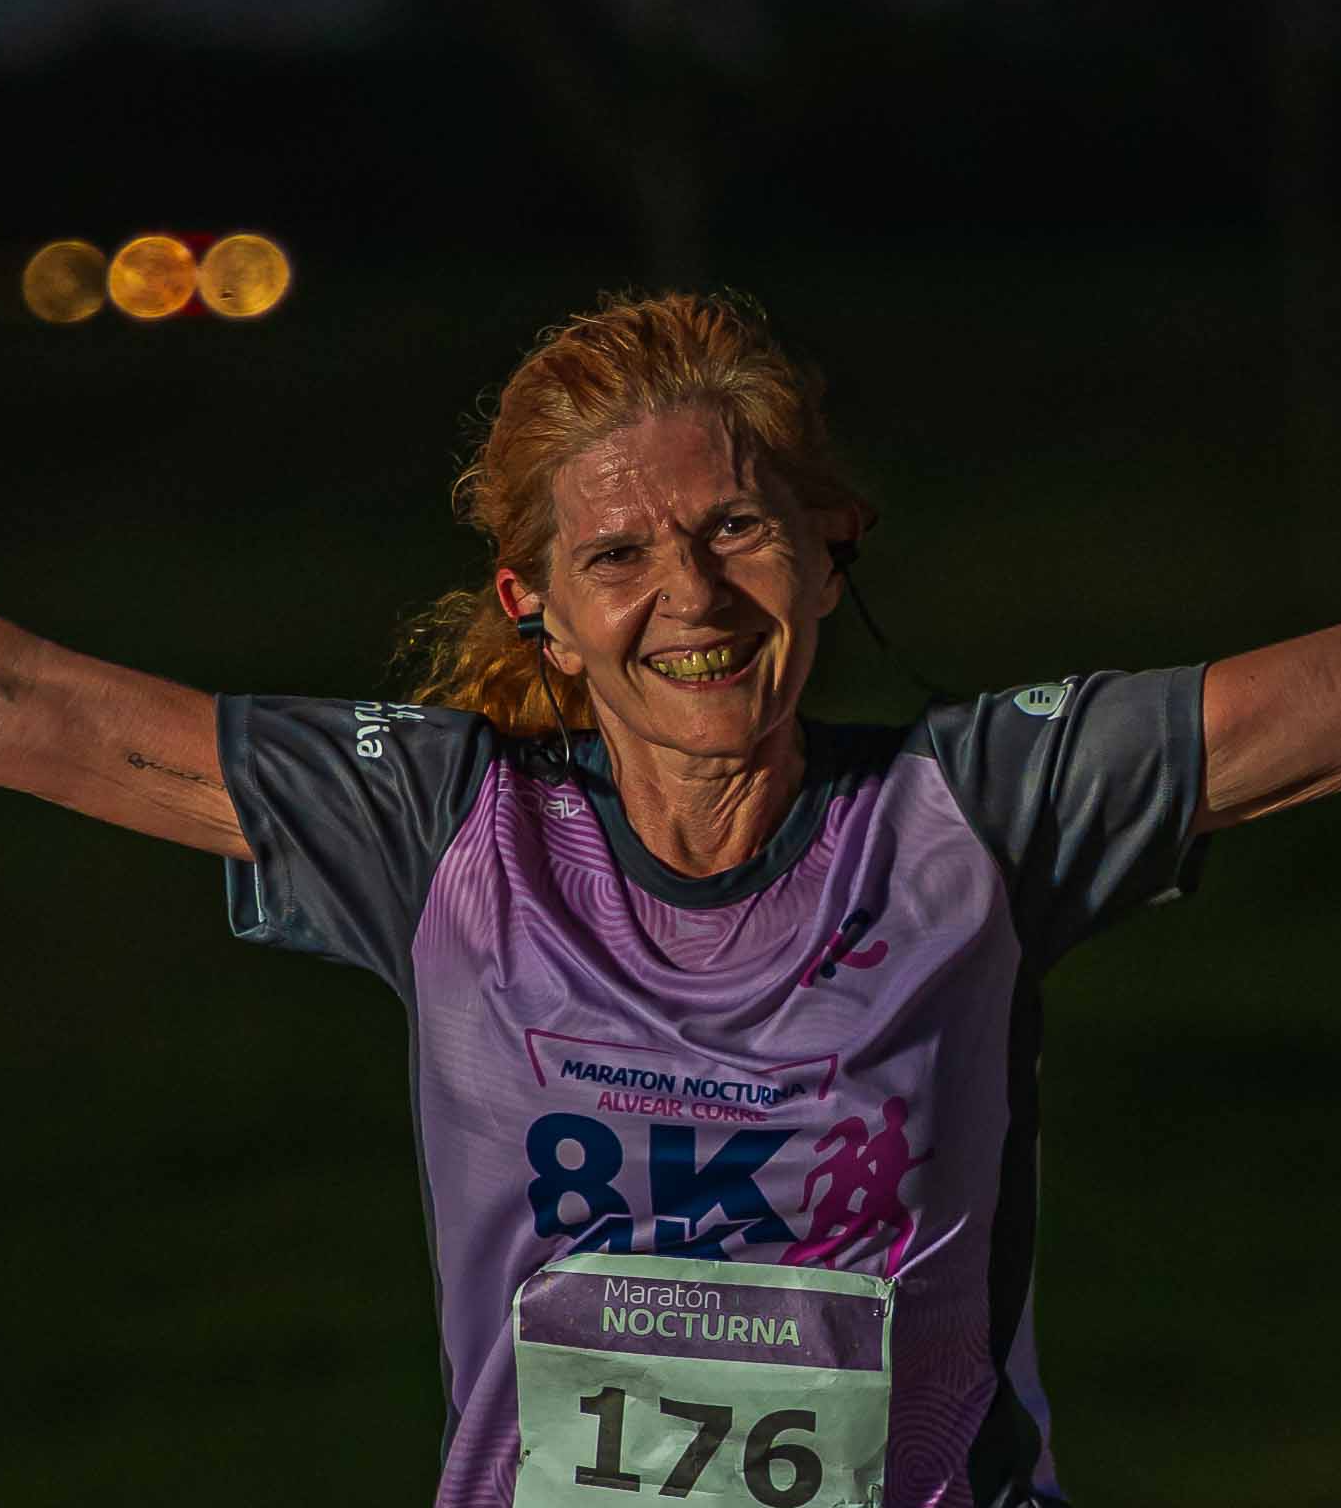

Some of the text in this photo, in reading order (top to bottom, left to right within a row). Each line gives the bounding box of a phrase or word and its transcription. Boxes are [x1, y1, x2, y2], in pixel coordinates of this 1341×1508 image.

[560, 1059, 676, 1093] MARATON
[597, 1091, 682, 1117] ALVEAR
[527, 1113, 802, 1242] 8K
[603, 1278, 721, 1310] Maratón
[602, 1307, 801, 1347] NOCTURNA
[575, 1386, 823, 1508] 176
